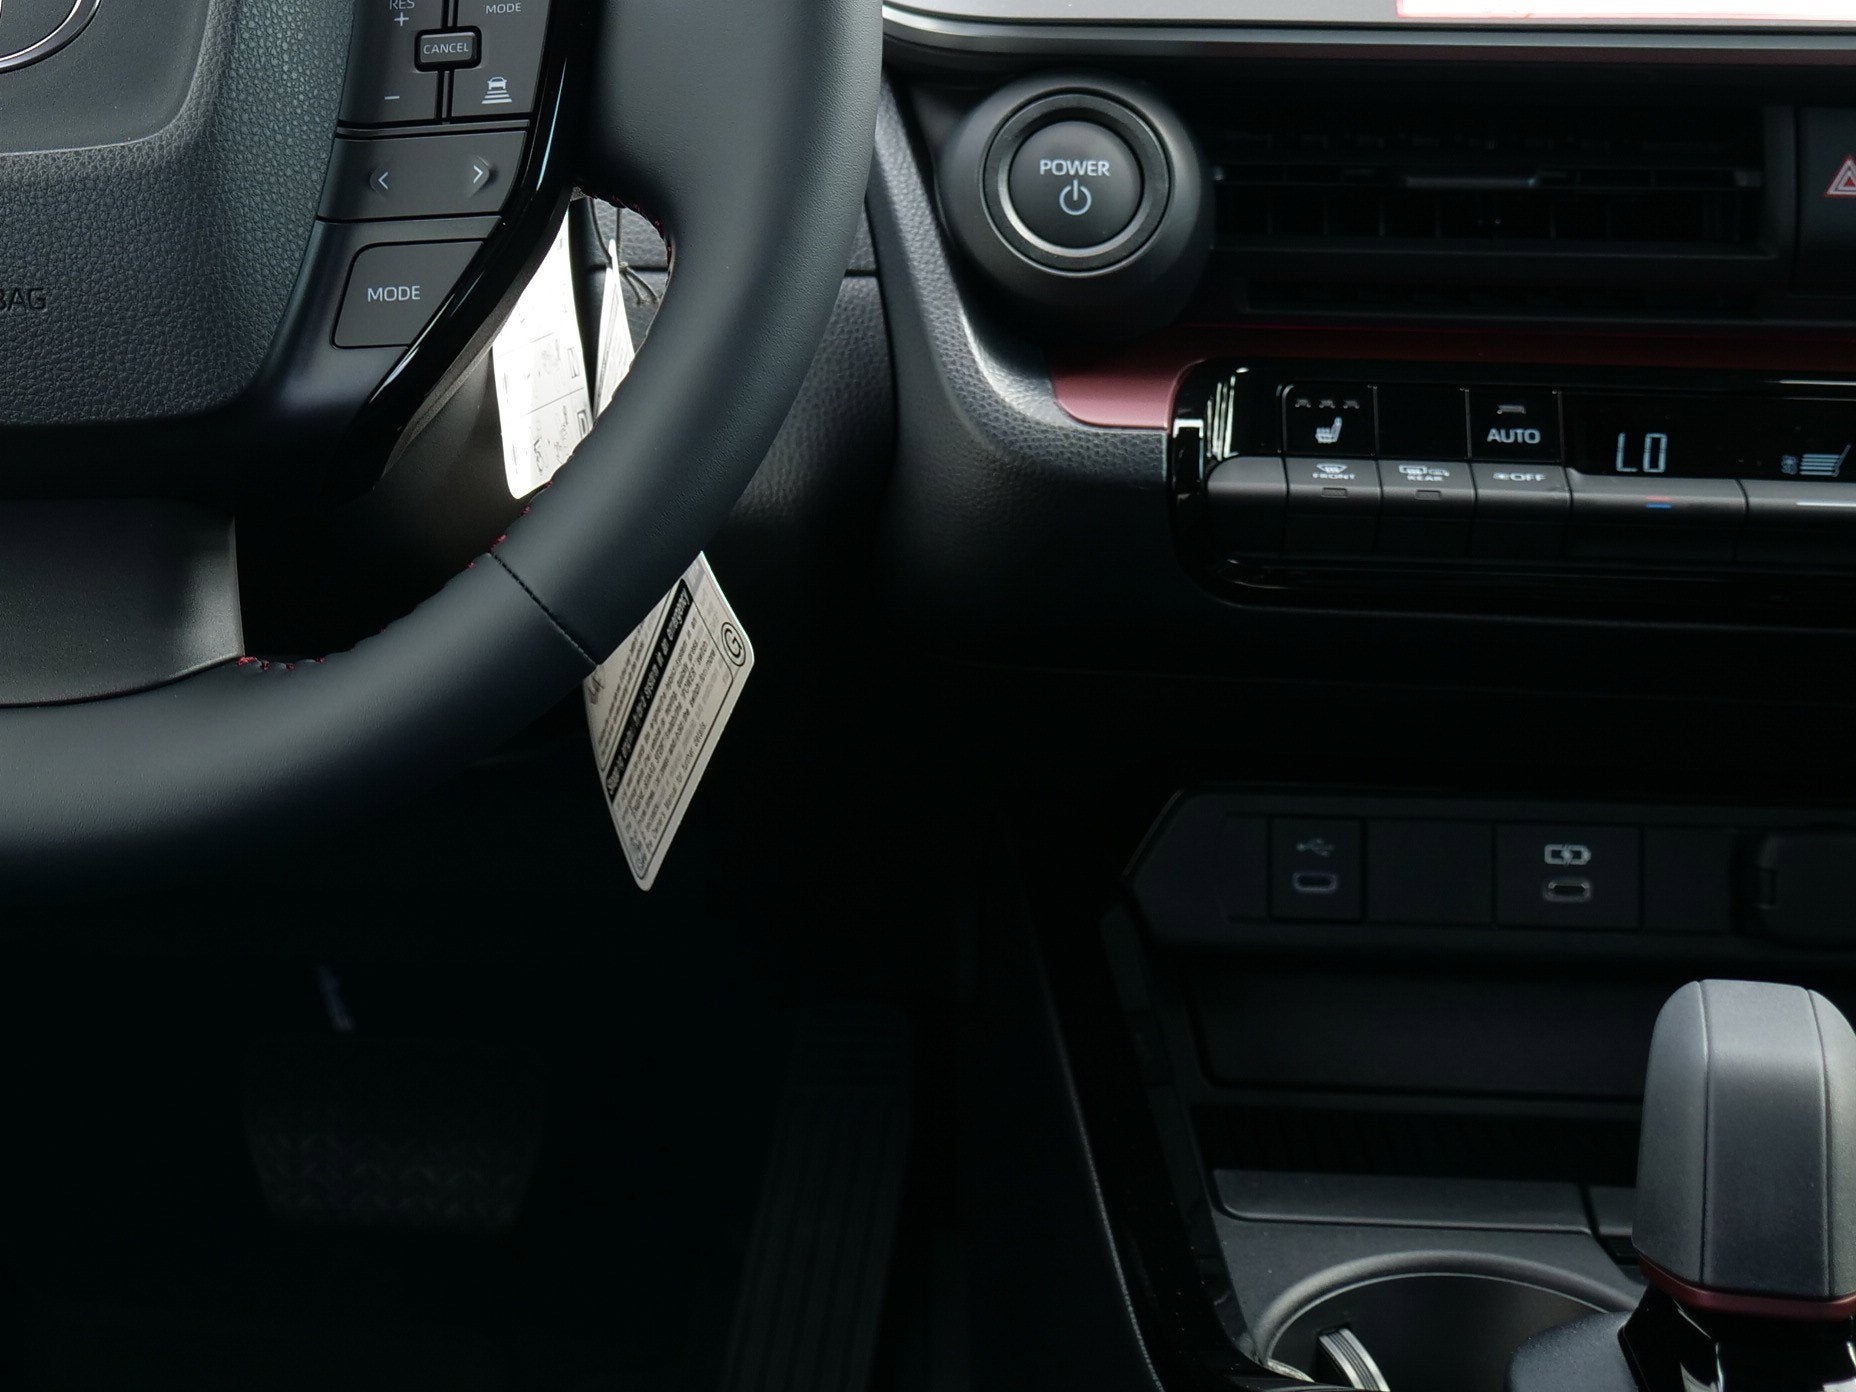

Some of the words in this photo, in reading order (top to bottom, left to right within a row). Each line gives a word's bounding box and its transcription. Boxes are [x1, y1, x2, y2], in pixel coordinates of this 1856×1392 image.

[485, 3, 522, 14] MODE
[423, 43, 469, 54] CANCEL
[1039, 159, 1110, 176] POWER
[367, 285, 421, 302] MODE
[1486, 428, 1541, 444] AUTO
[1616, 432, 1668, 473] LO
[1312, 473, 1356, 481] FRONT
[1407, 474, 1443, 482] REAR
[1510, 472, 1546, 482] OFF
[724, 627, 743, 659] G
